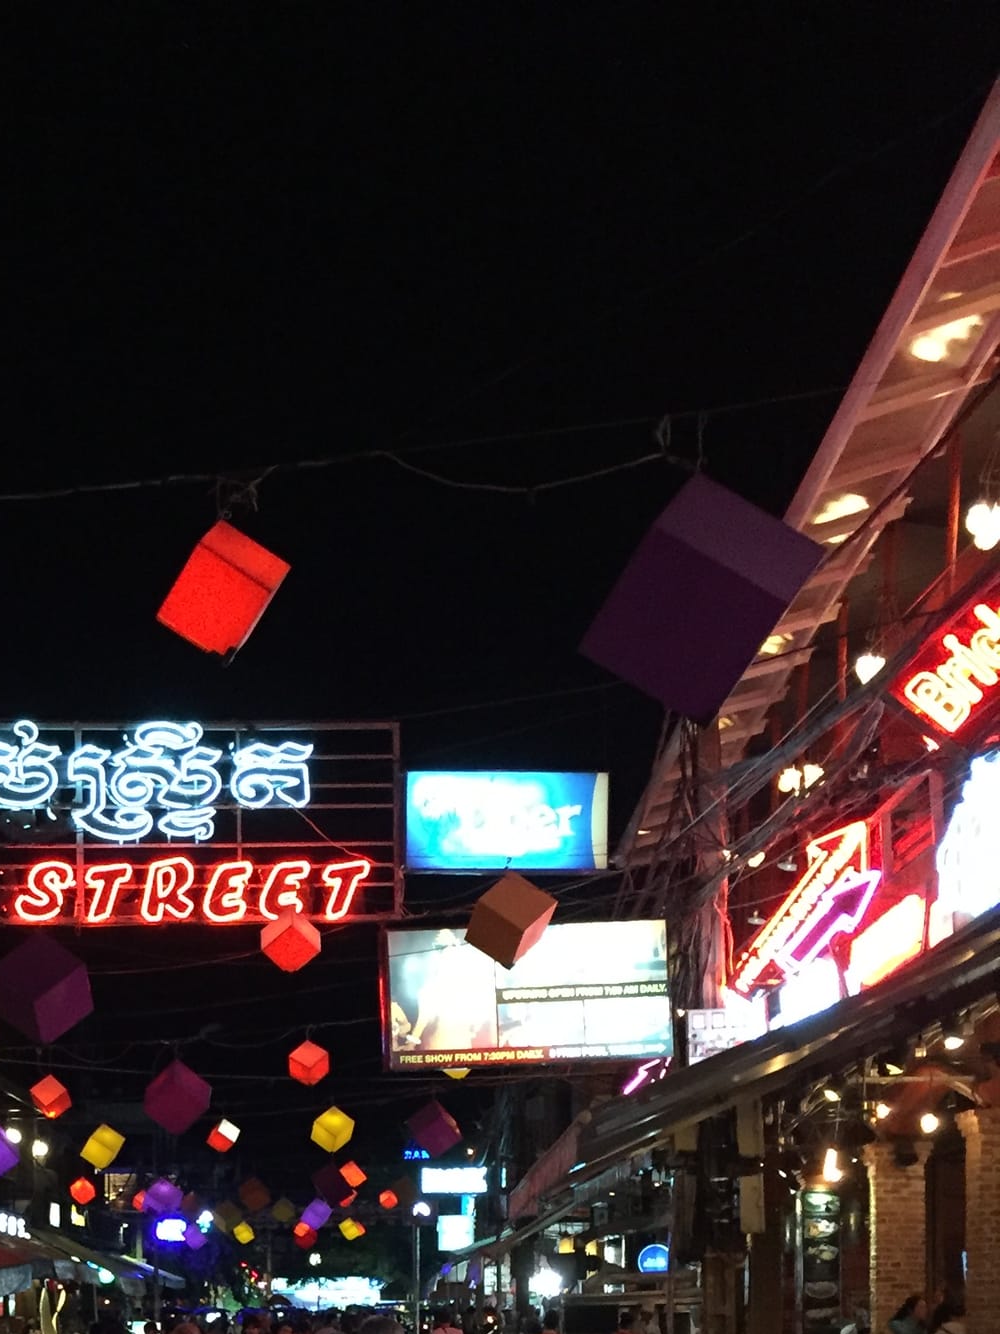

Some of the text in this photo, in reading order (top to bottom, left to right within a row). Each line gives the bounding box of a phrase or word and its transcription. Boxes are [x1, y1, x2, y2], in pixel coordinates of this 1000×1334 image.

[14, 856, 368, 922] STREET
[400, 1055, 423, 1064] FREE
[425, 1054, 453, 1063] SHOW
[454, 1053, 482, 1062] FROM
